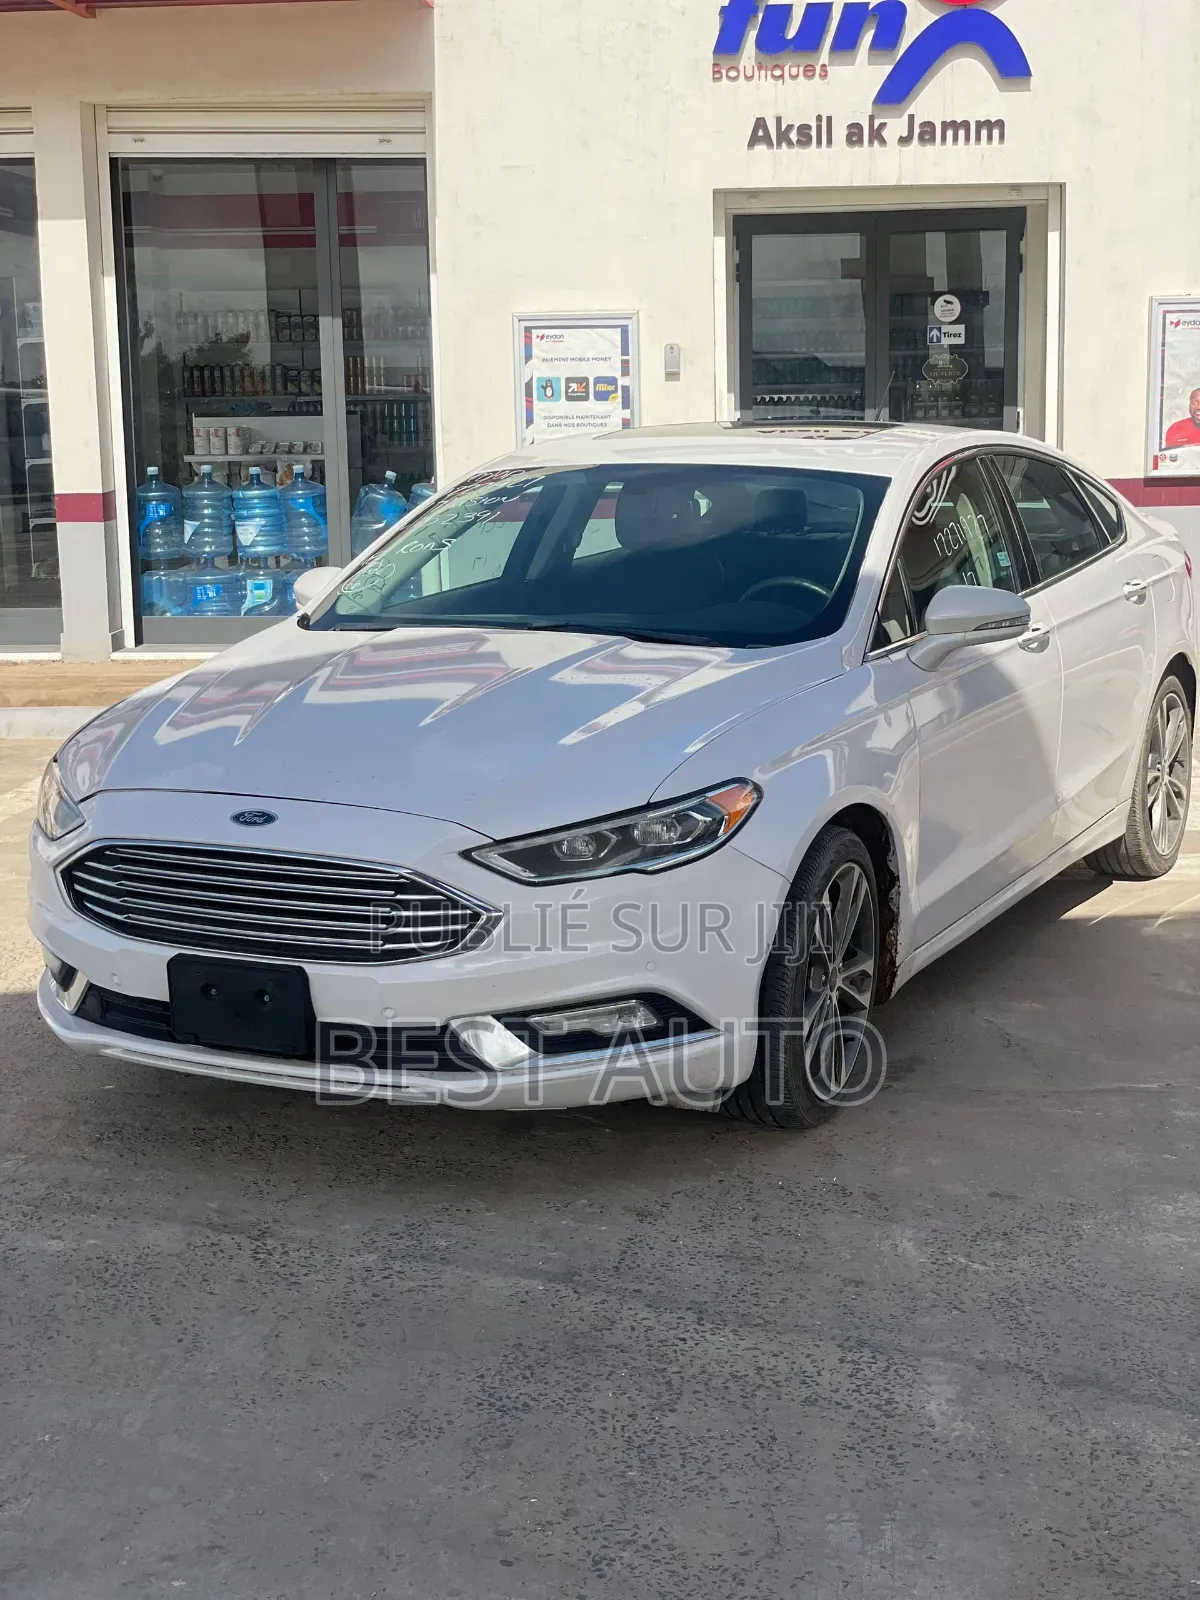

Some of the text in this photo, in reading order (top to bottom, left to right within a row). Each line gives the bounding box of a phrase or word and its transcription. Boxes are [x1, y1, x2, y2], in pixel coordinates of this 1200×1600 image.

[712, 62, 829, 84] Boutiques
[747, 114, 1006, 150] Aksil ak Jamm
[240, 811, 268, 823] Ford
